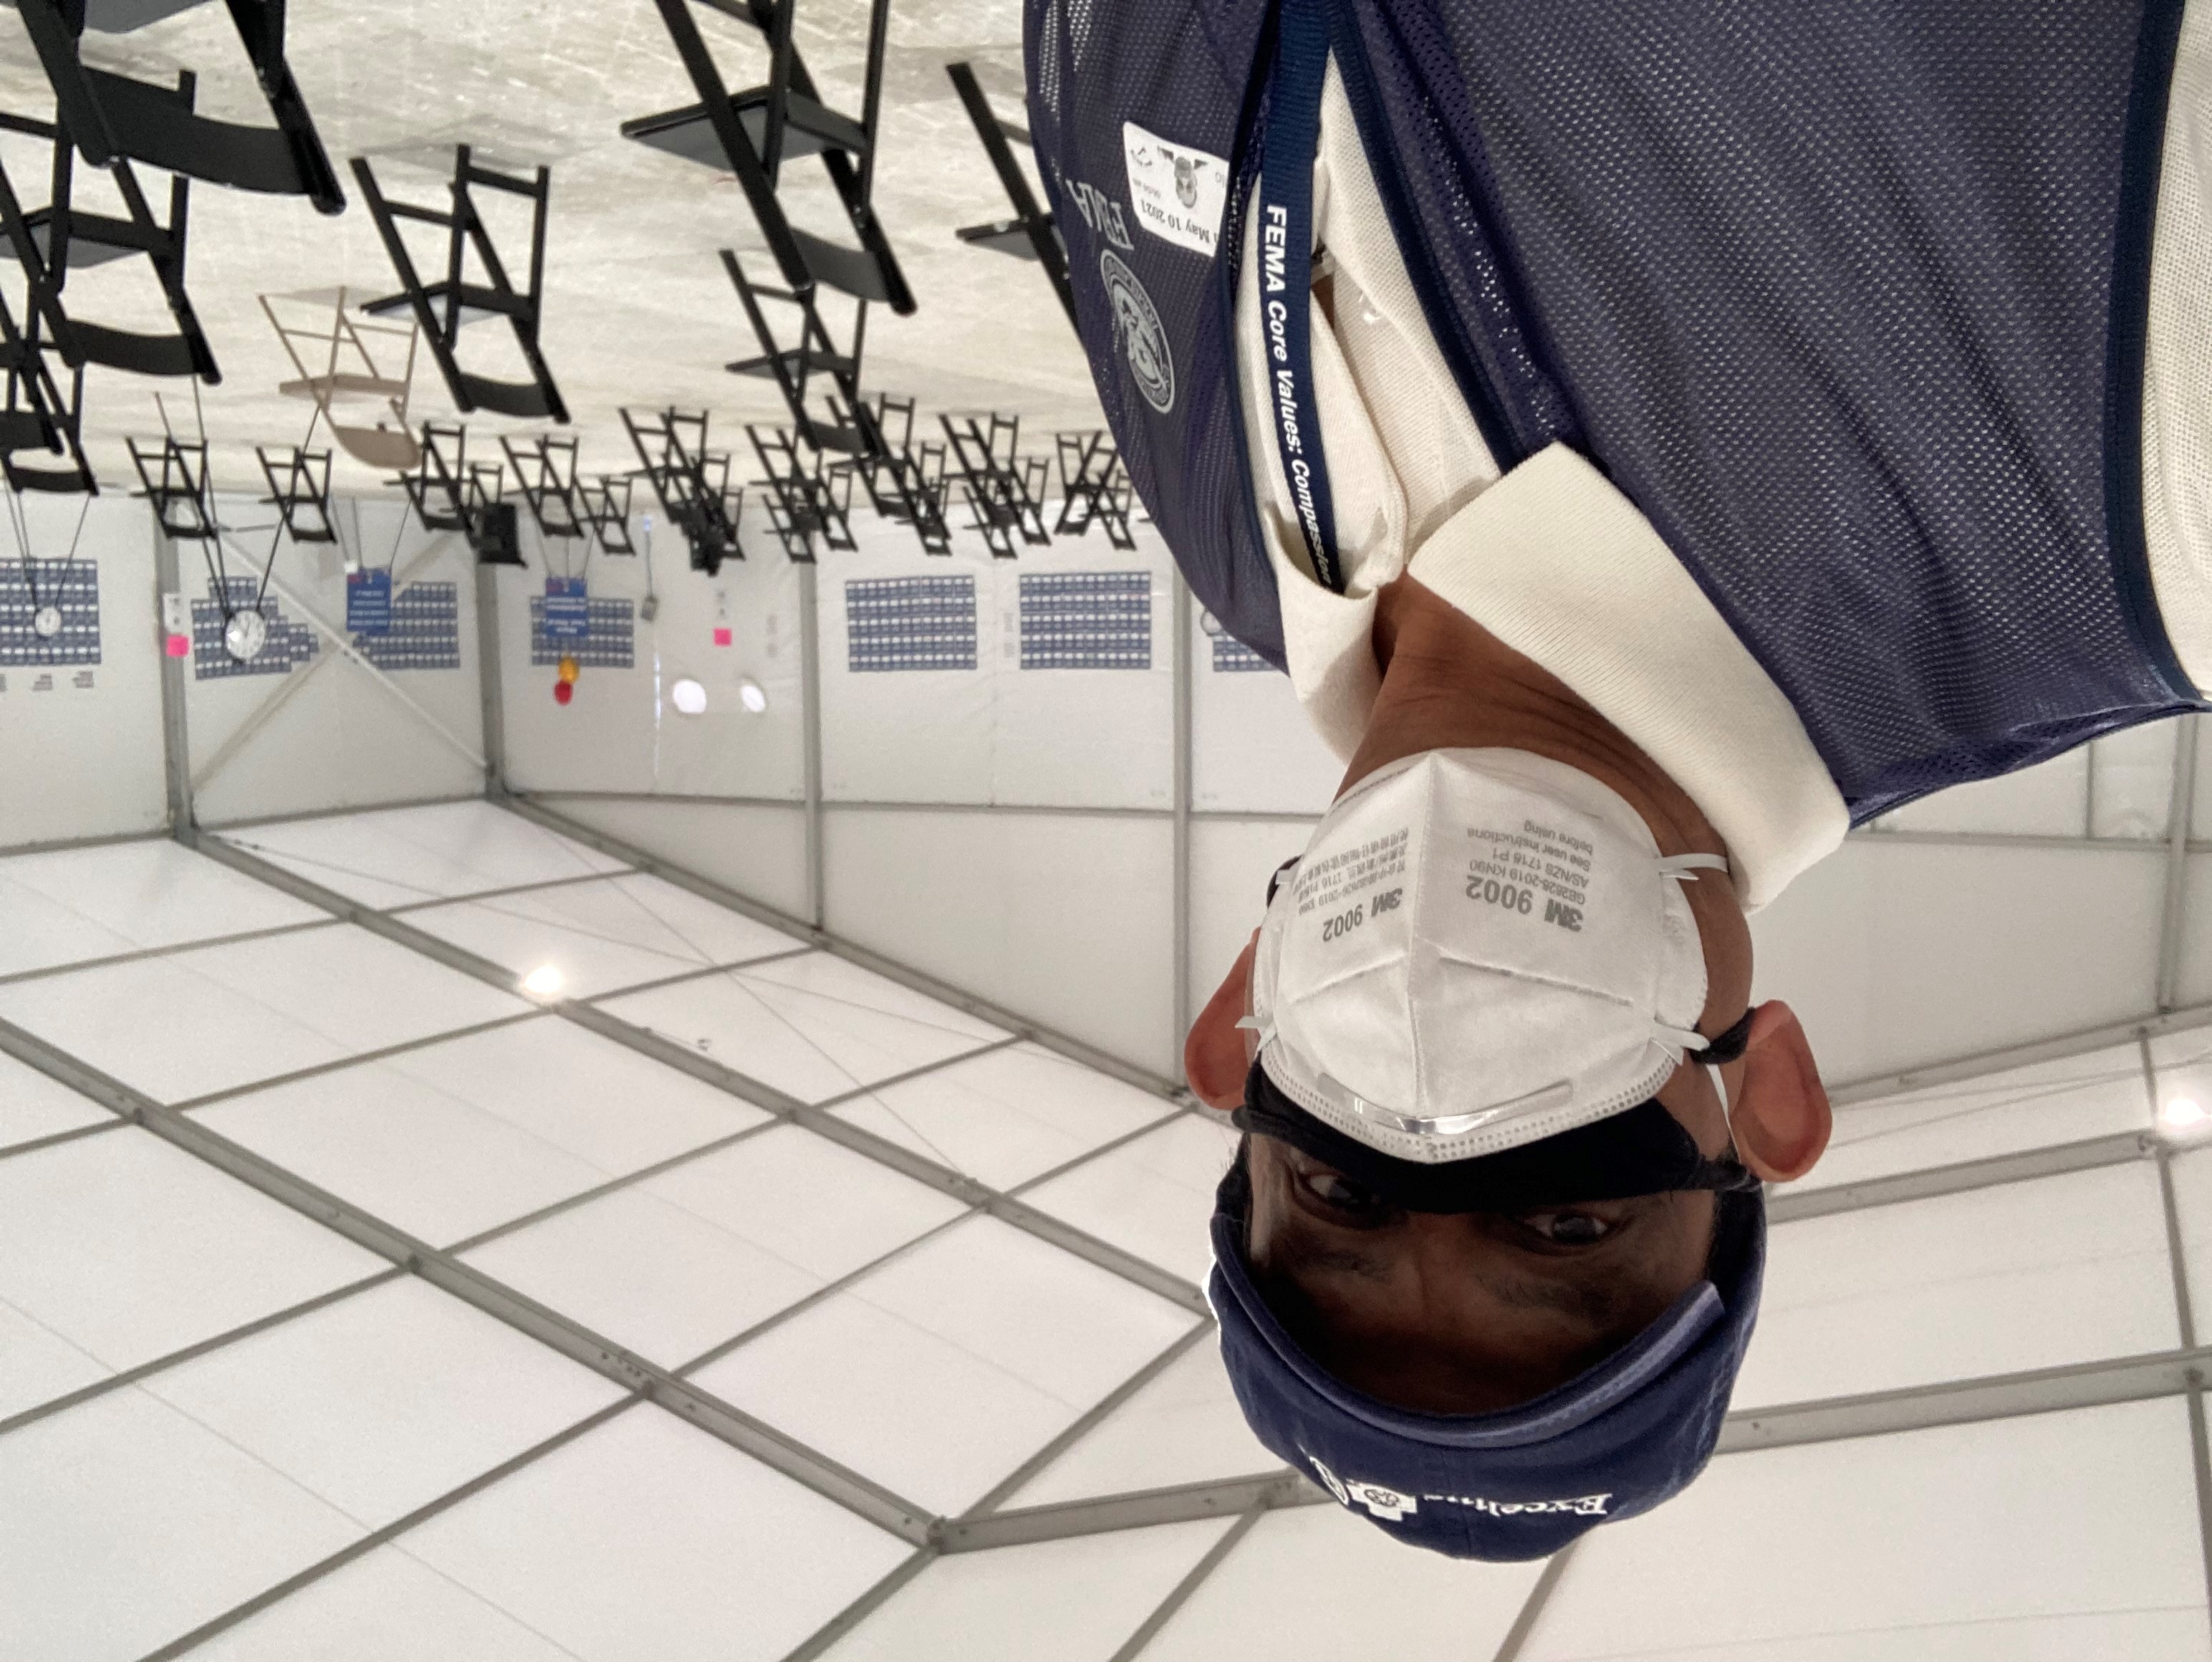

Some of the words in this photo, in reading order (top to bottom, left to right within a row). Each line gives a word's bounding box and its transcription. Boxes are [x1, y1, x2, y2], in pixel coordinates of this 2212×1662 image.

[1140, 199, 1165, 223] 2021
[1168, 213, 1181, 231] 10
[1186, 219, 1210, 244] May
[1264, 203, 1287, 292] FEMA
[1267, 300, 1288, 361] Core
[1274, 368, 1302, 454] Values:
[1292, 458, 1332, 585] Compassion
[1467, 827, 1539, 854] instructions
[1524, 820, 1555, 841] using
[1493, 847, 1509, 862] P1
[1542, 844, 1567, 860] user
[1559, 833, 1593, 857] before
[1469, 859, 1506, 878] KN90
[1513, 852, 1541, 870] 1716
[1569, 855, 1591, 872] See
[1321, 872, 1342, 890] 1716
[1545, 863, 1589, 889] AS/NZS
[1371, 888, 1403, 918] 3M
[1465, 875, 1532, 915] 9002
[1322, 903, 1362, 942] 9002
[1544, 898, 1583, 932] 3M
